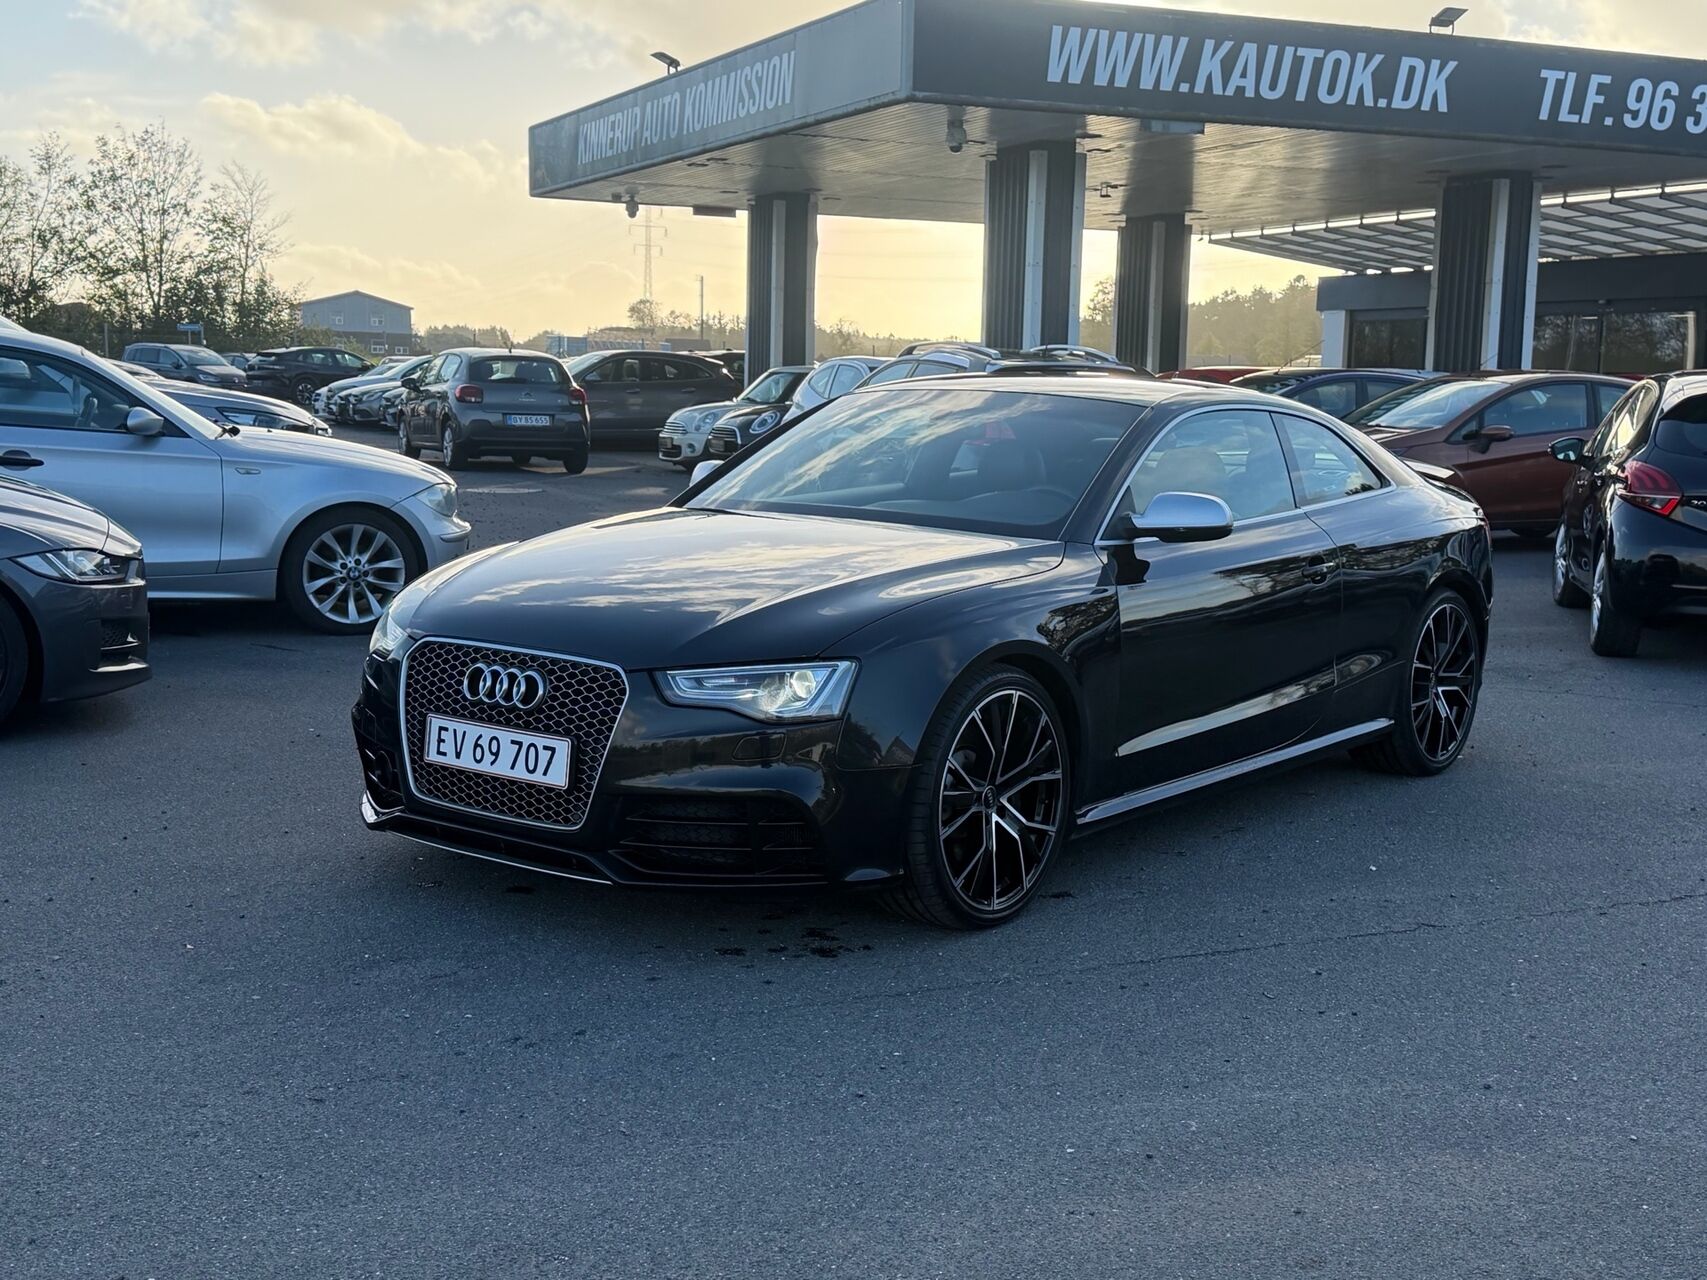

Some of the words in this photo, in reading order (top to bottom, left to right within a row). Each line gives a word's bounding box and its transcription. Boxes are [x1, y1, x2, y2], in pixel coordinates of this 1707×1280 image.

[1046, 24, 1459, 113] WWW.KAUTOK.DK
[1538, 68, 1613, 126] TLF.
[1623, 77, 1681, 131] 96
[578, 106, 641, 165] KINNERUP
[641, 91, 680, 147] AUTO
[683, 51, 796, 135] KOMMISSION
[436, 725, 467, 760] EV
[472, 733, 501, 766] 69
[509, 739, 557, 776] 707
